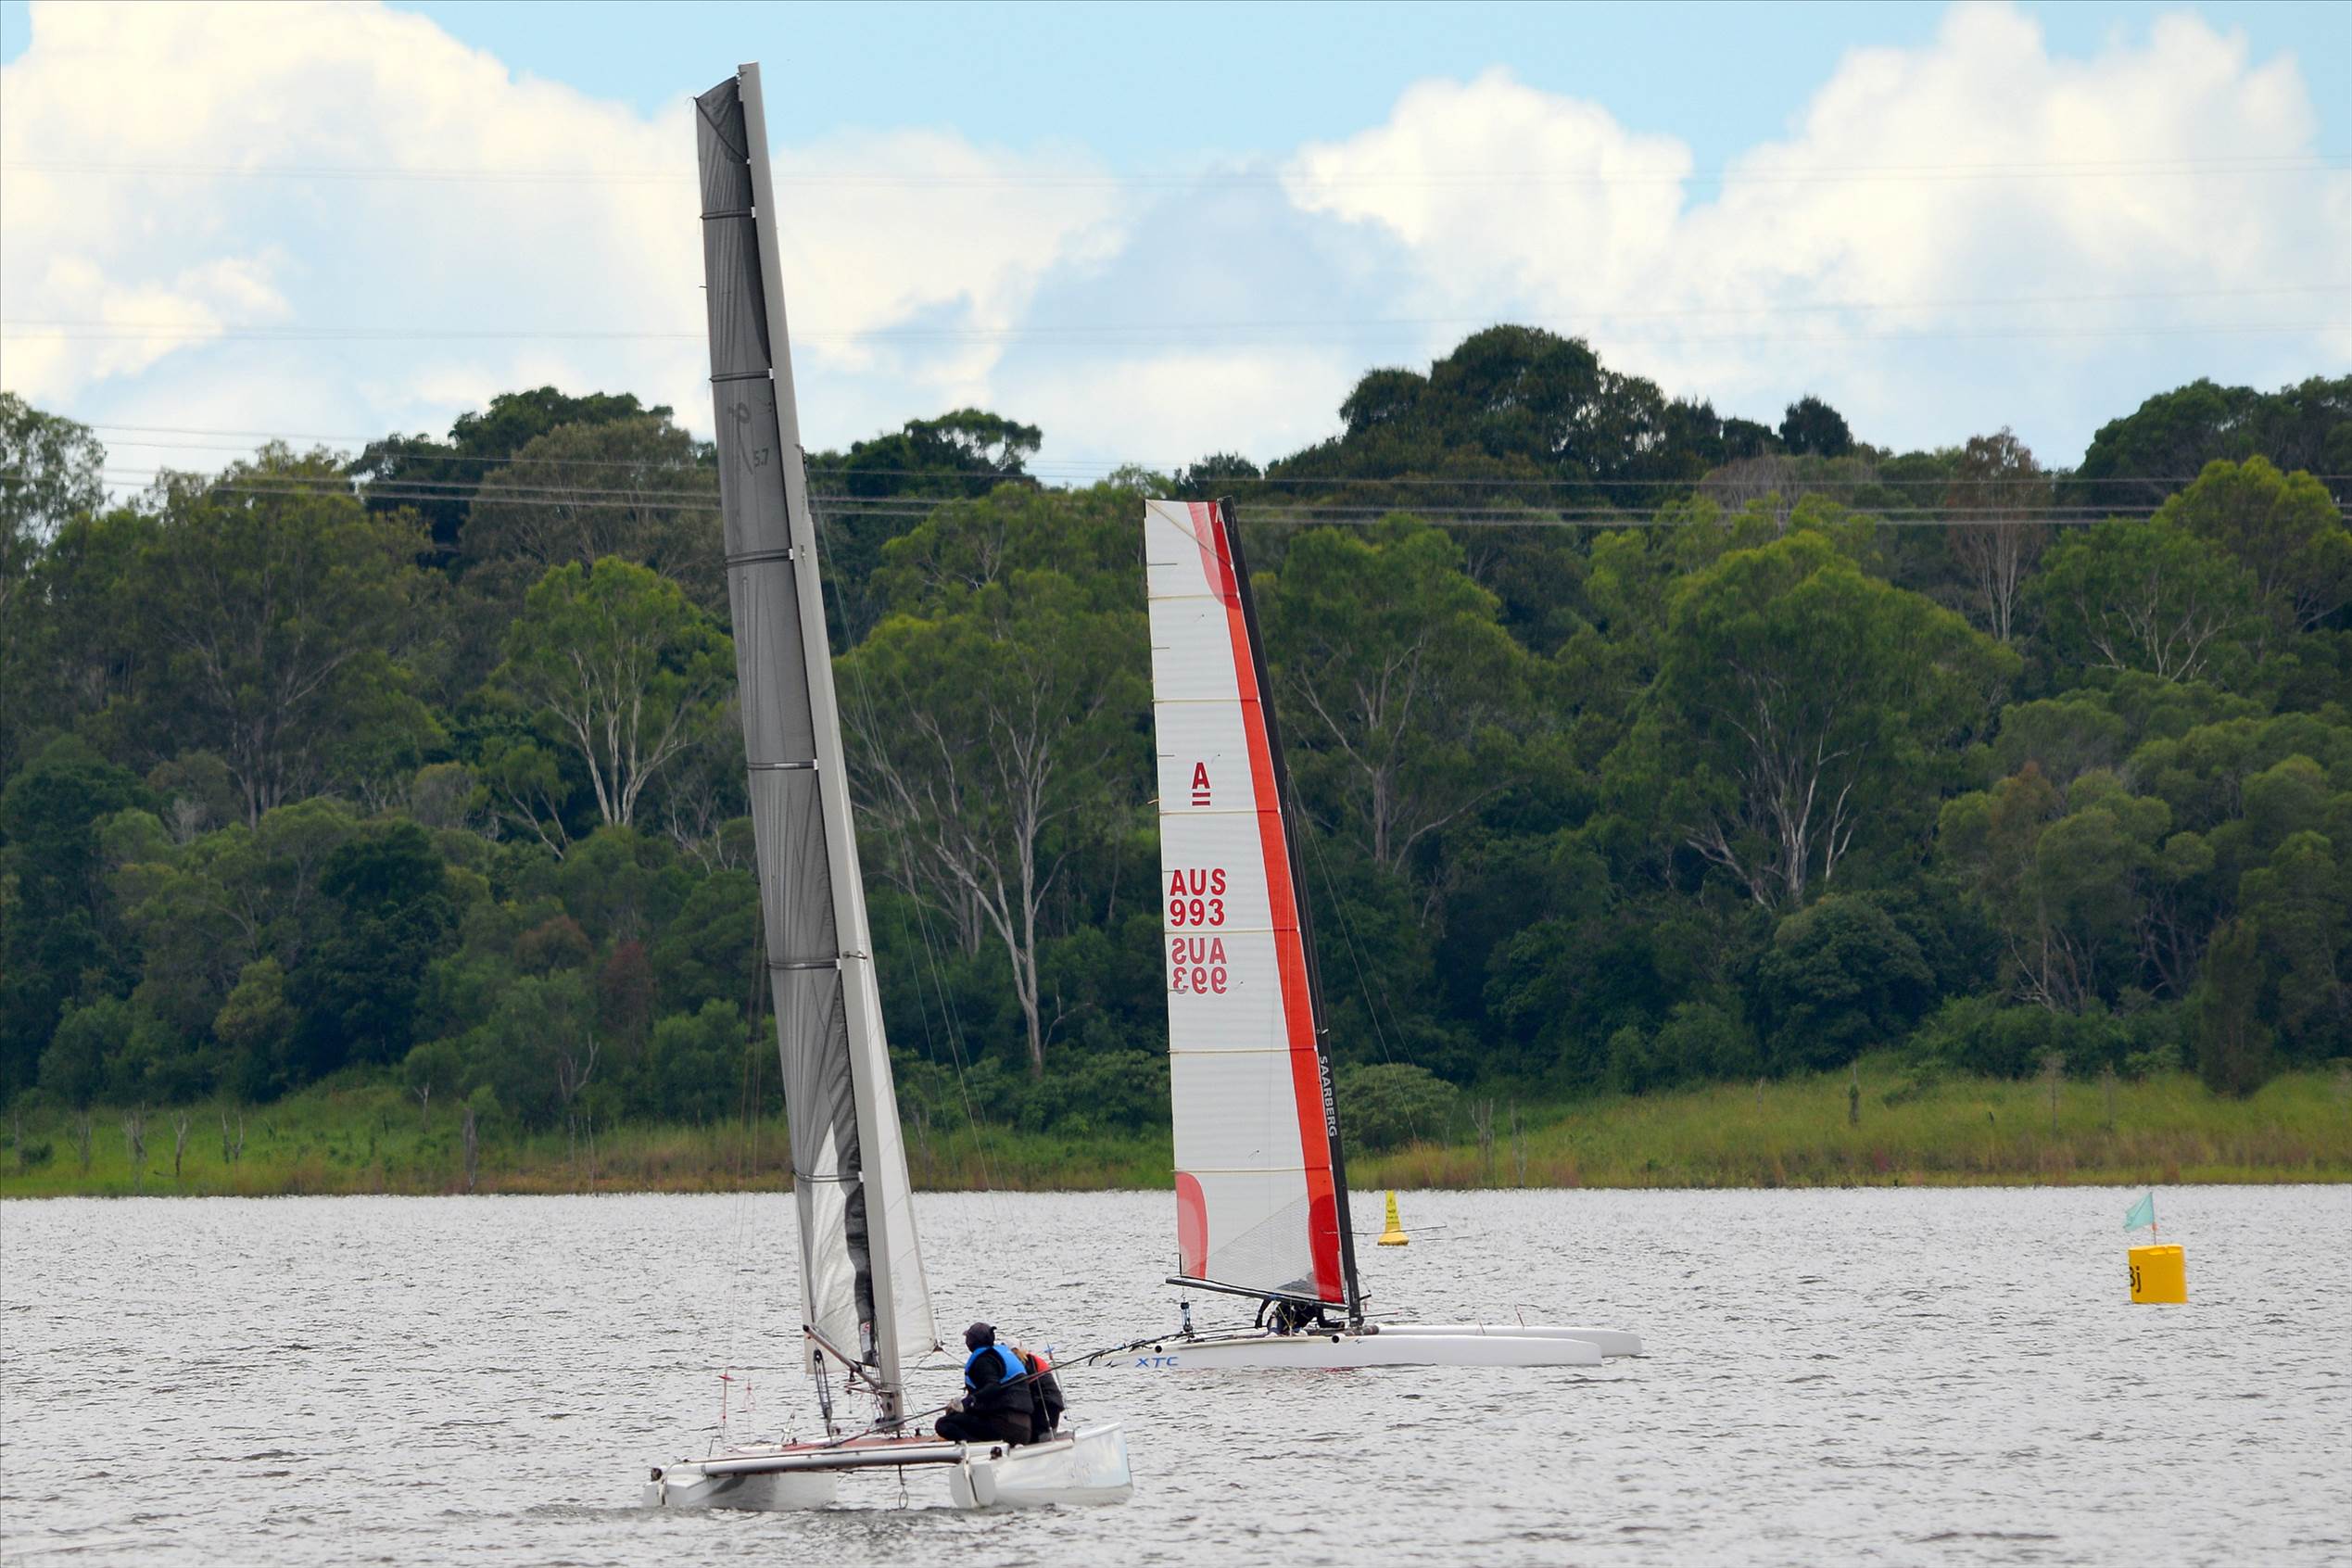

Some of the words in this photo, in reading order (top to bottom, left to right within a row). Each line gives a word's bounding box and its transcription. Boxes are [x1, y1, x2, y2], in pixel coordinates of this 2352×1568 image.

[1192, 762, 1210, 789] A
[1170, 868, 1226, 896] AUS
[1170, 899, 1224, 927] 993
[1319, 1056, 1337, 1137] SAARBERG
[1135, 1357, 1178, 1368] XTC
